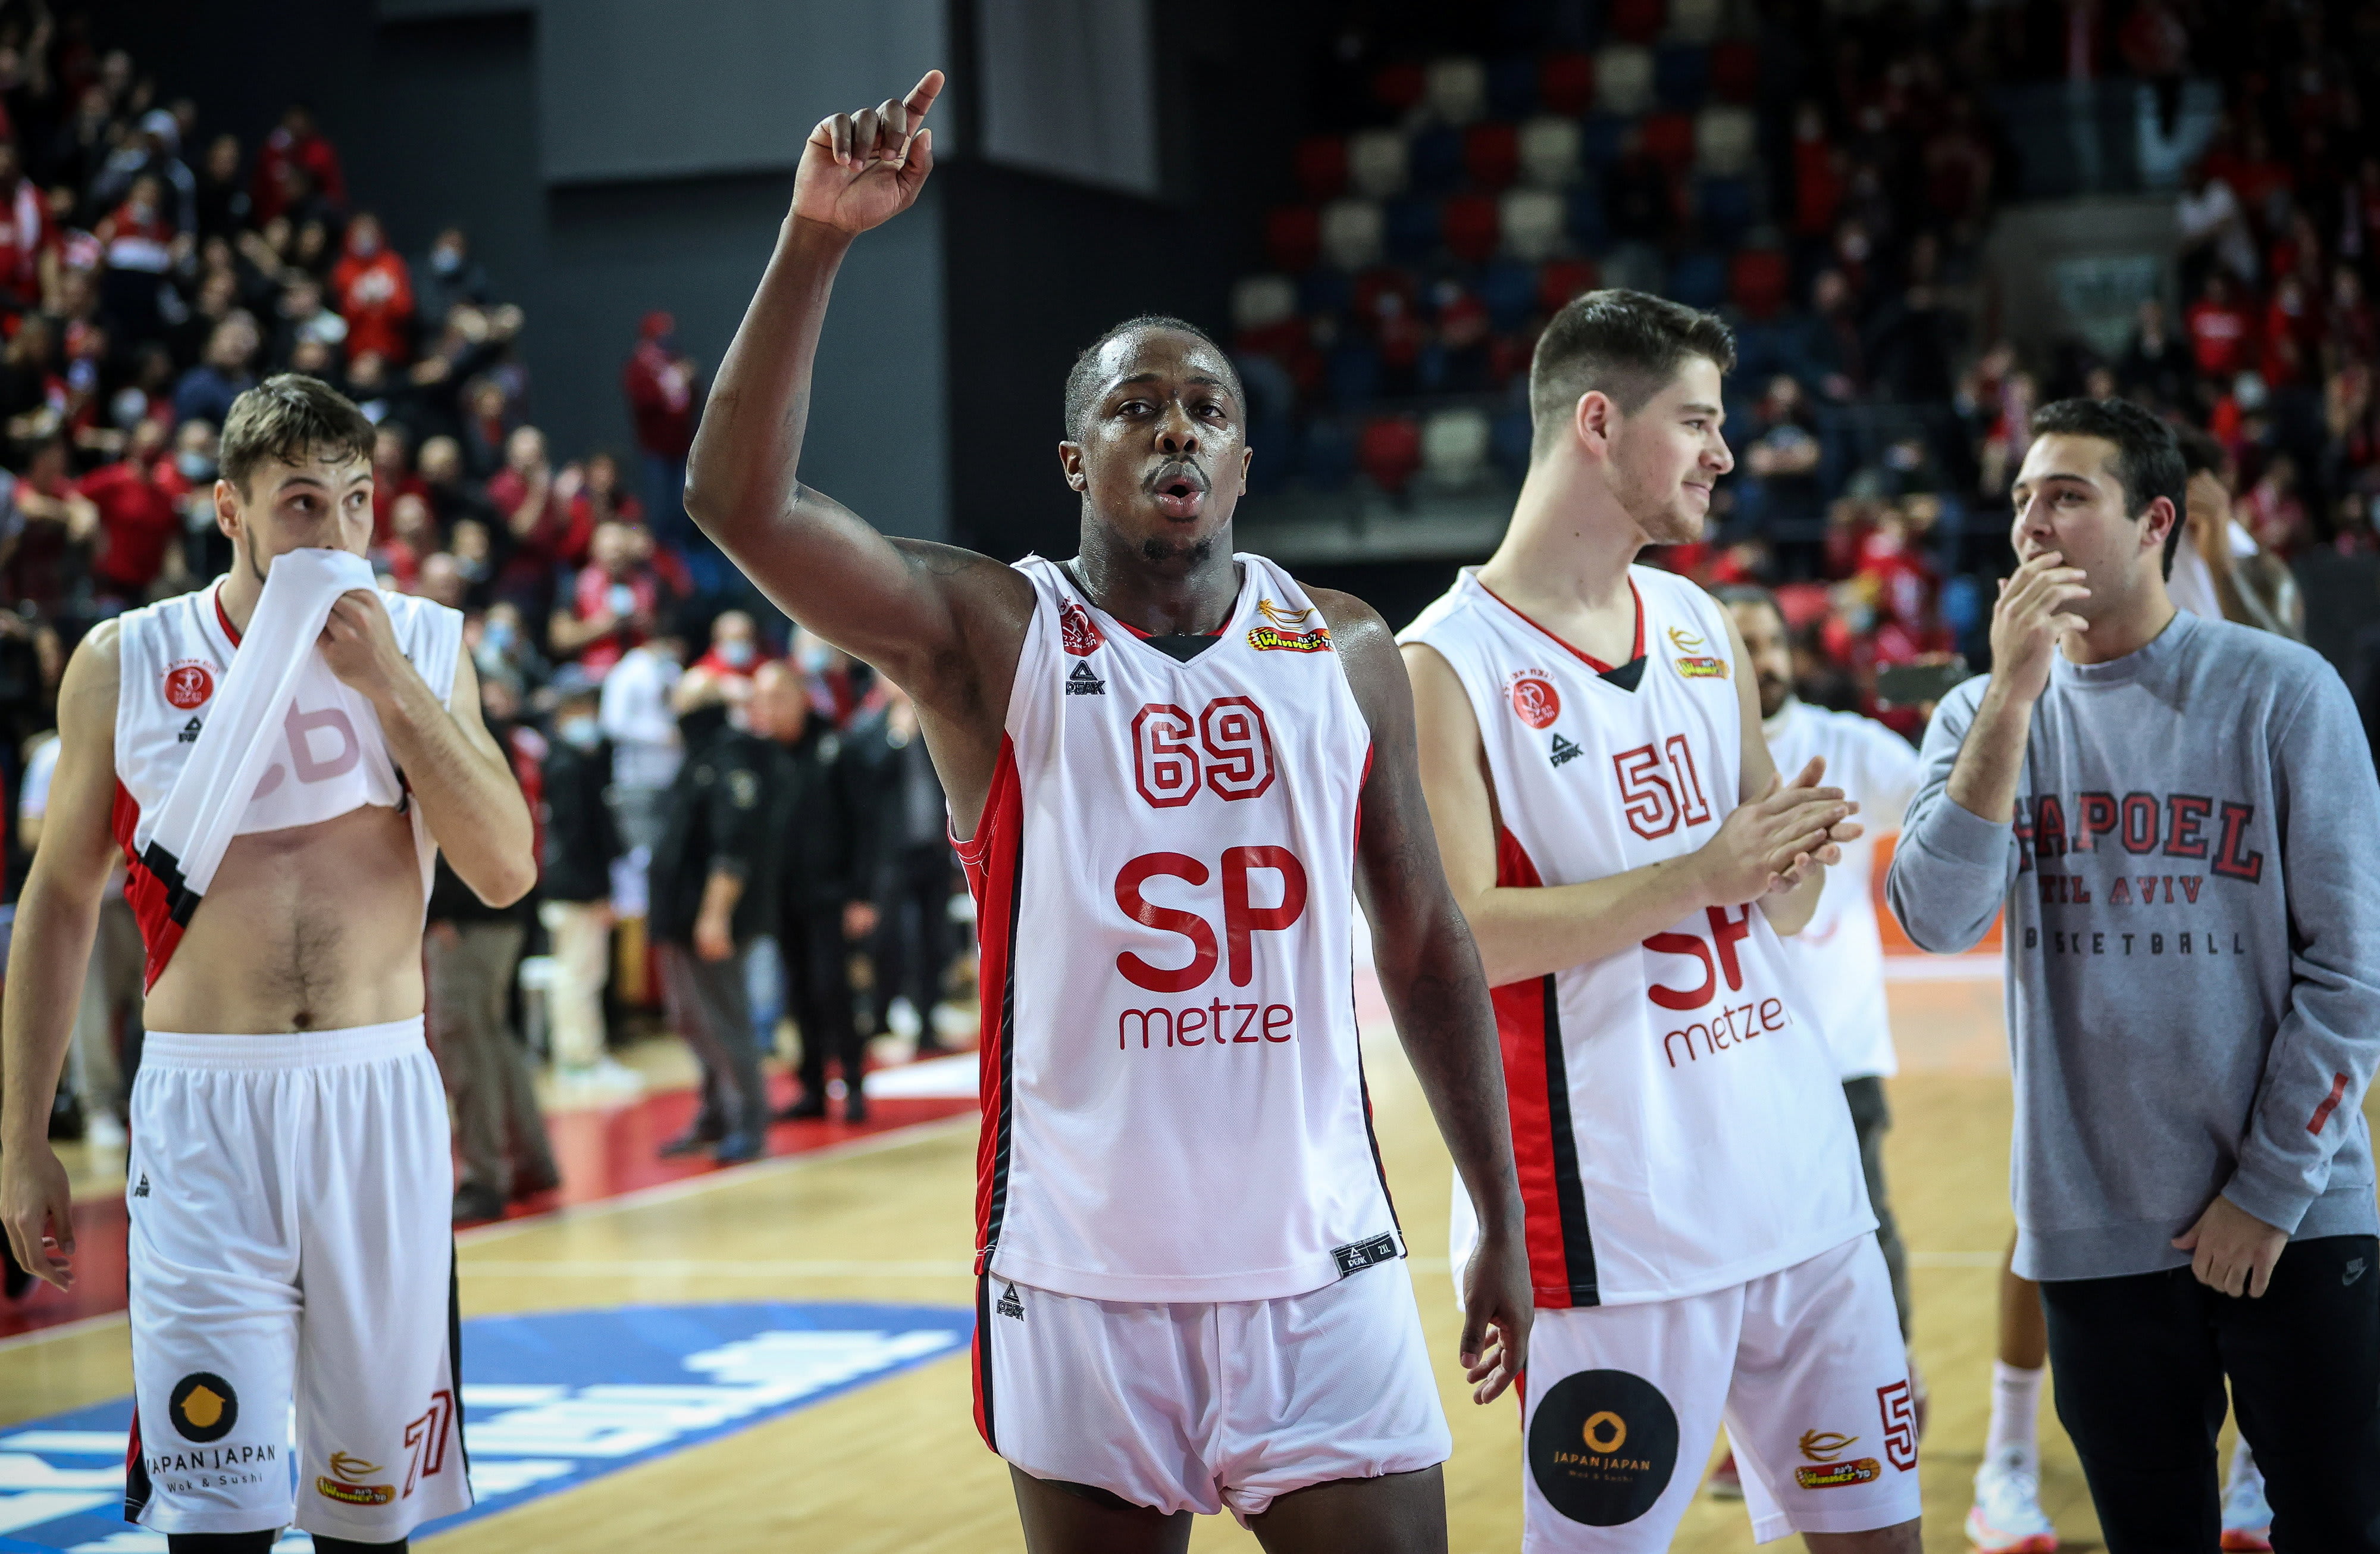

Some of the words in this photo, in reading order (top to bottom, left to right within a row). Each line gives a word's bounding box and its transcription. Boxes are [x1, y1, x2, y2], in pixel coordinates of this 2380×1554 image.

[1259, 631, 1321, 649] Winner
[1297, 633, 1316, 643] ליגת
[1066, 681, 1106, 695] PEAK
[1131, 695, 1275, 808] 69
[1612, 733, 1711, 840] 51
[2108, 876, 2203, 904] AVIV
[1114, 845, 1307, 993] SP
[2025, 927, 2246, 955] BSKETBALL
[1119, 997, 1299, 1050] metze
[1664, 998, 1793, 1068] metze
[1377, 1243, 1391, 1255] 2XL
[1347, 1255, 1368, 1268] PEAK
[997, 1299, 1025, 1321] PEAK
[215, 1444, 275, 1469] JAPAN
[1554, 1451, 1600, 1467] JAPAN
[1603, 1458, 1651, 1471] JAPAN
[167, 1480, 193, 1493] Wok
[202, 1477, 210, 1487] &
[220, 1473, 263, 1486] Sushi
